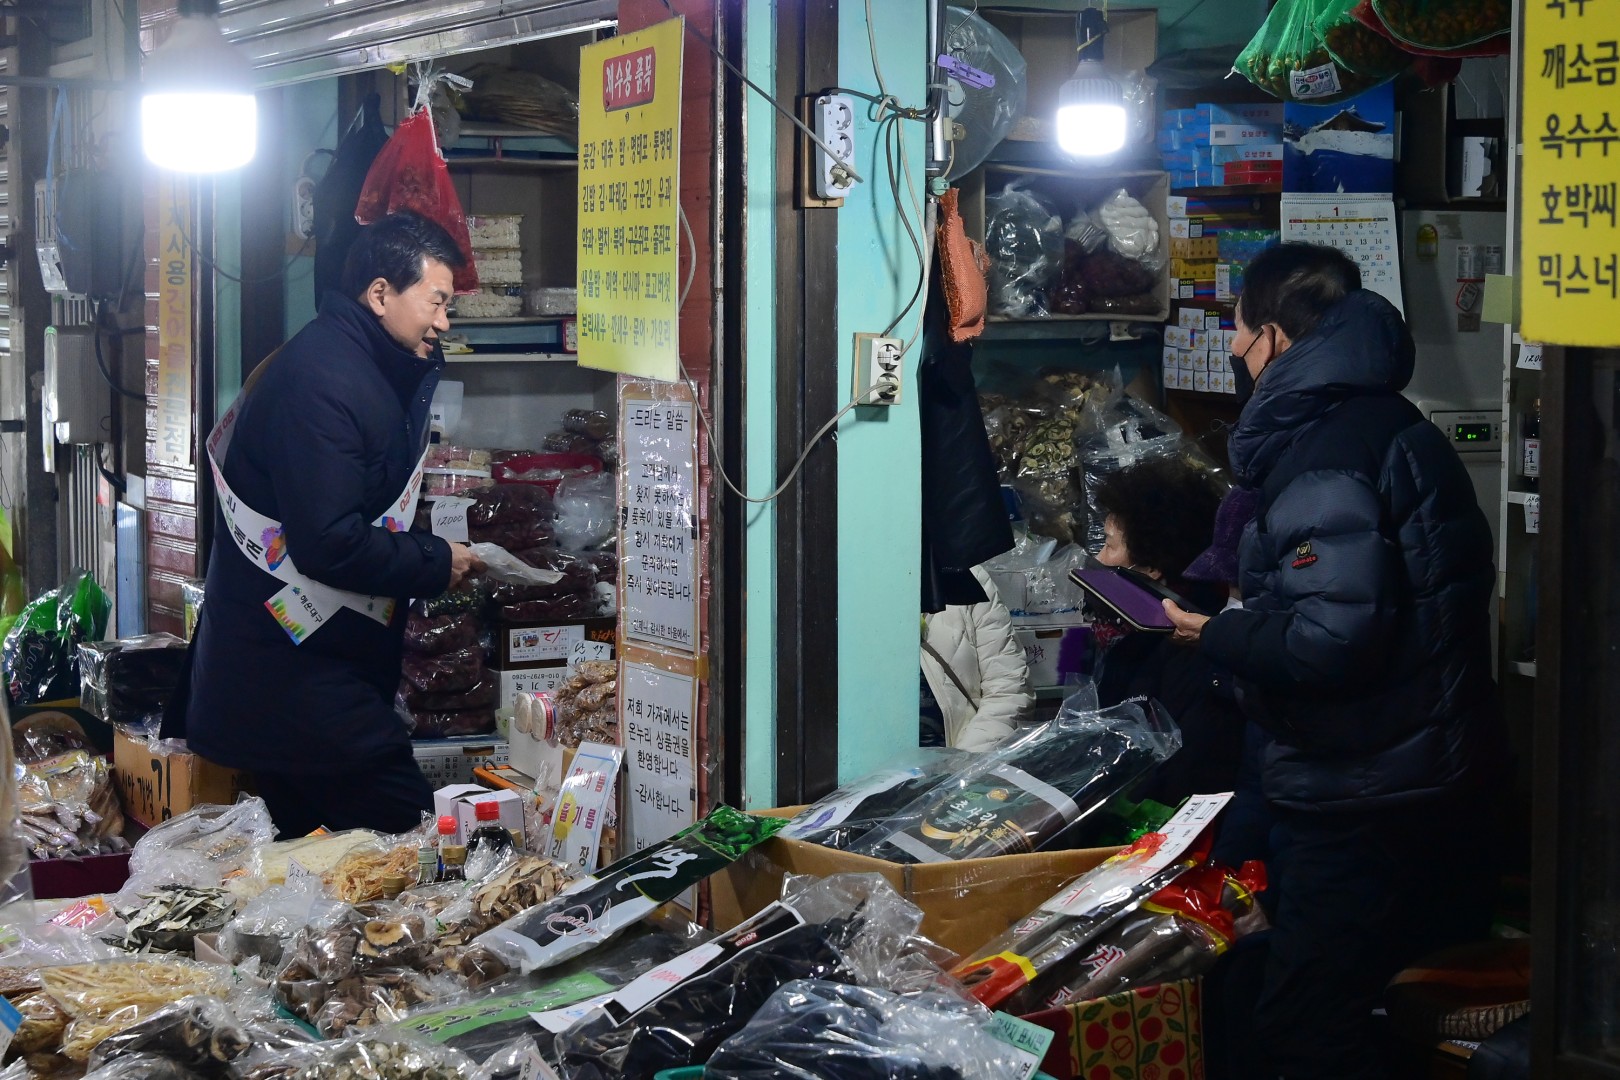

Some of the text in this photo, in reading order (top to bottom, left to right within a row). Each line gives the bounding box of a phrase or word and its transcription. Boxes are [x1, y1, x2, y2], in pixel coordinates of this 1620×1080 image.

[606, 54, 652, 100] 제수용 품목
[1540, 41, 1620, 89] 깨소금
[584, 128, 672, 170] 곶감 대추 밤 명태포 통명태
[1540, 112, 1620, 158] 옥수수
[583, 176, 672, 213] 김밥 김 파래김 구운김 유과
[1538, 183, 1616, 228] 호박씨
[582, 227, 594, 256] 약과
[598, 226, 610, 256] 멸치
[628, 225, 649, 256] 구운쥐포
[606, 270, 618, 300] 미역
[623, 270, 640, 301] 다시마
[645, 271, 670, 303] 표고버섯
[1538, 253, 1617, 298] 믹스너
[582, 313, 606, 341] 보리새우
[633, 317, 645, 348] 문어
[651, 318, 671, 350] 가오리
[642, 463, 678, 482] 고객님께서
[636, 485, 650, 504] 찾지
[632, 508, 654, 527] 품목이
[657, 510, 673, 530] 있을
[635, 530, 684, 554] 항시 저희에게
[642, 554, 678, 577] 문의하시면
[627, 574, 694, 602] 즉시 찾아드립니다.
[627, 697, 690, 731] 저희 가게에서는
[628, 722, 690, 759] 온누리 상품권을
[637, 749, 682, 780] 환영합니다.
[559, 802, 597, 830] 들기름
